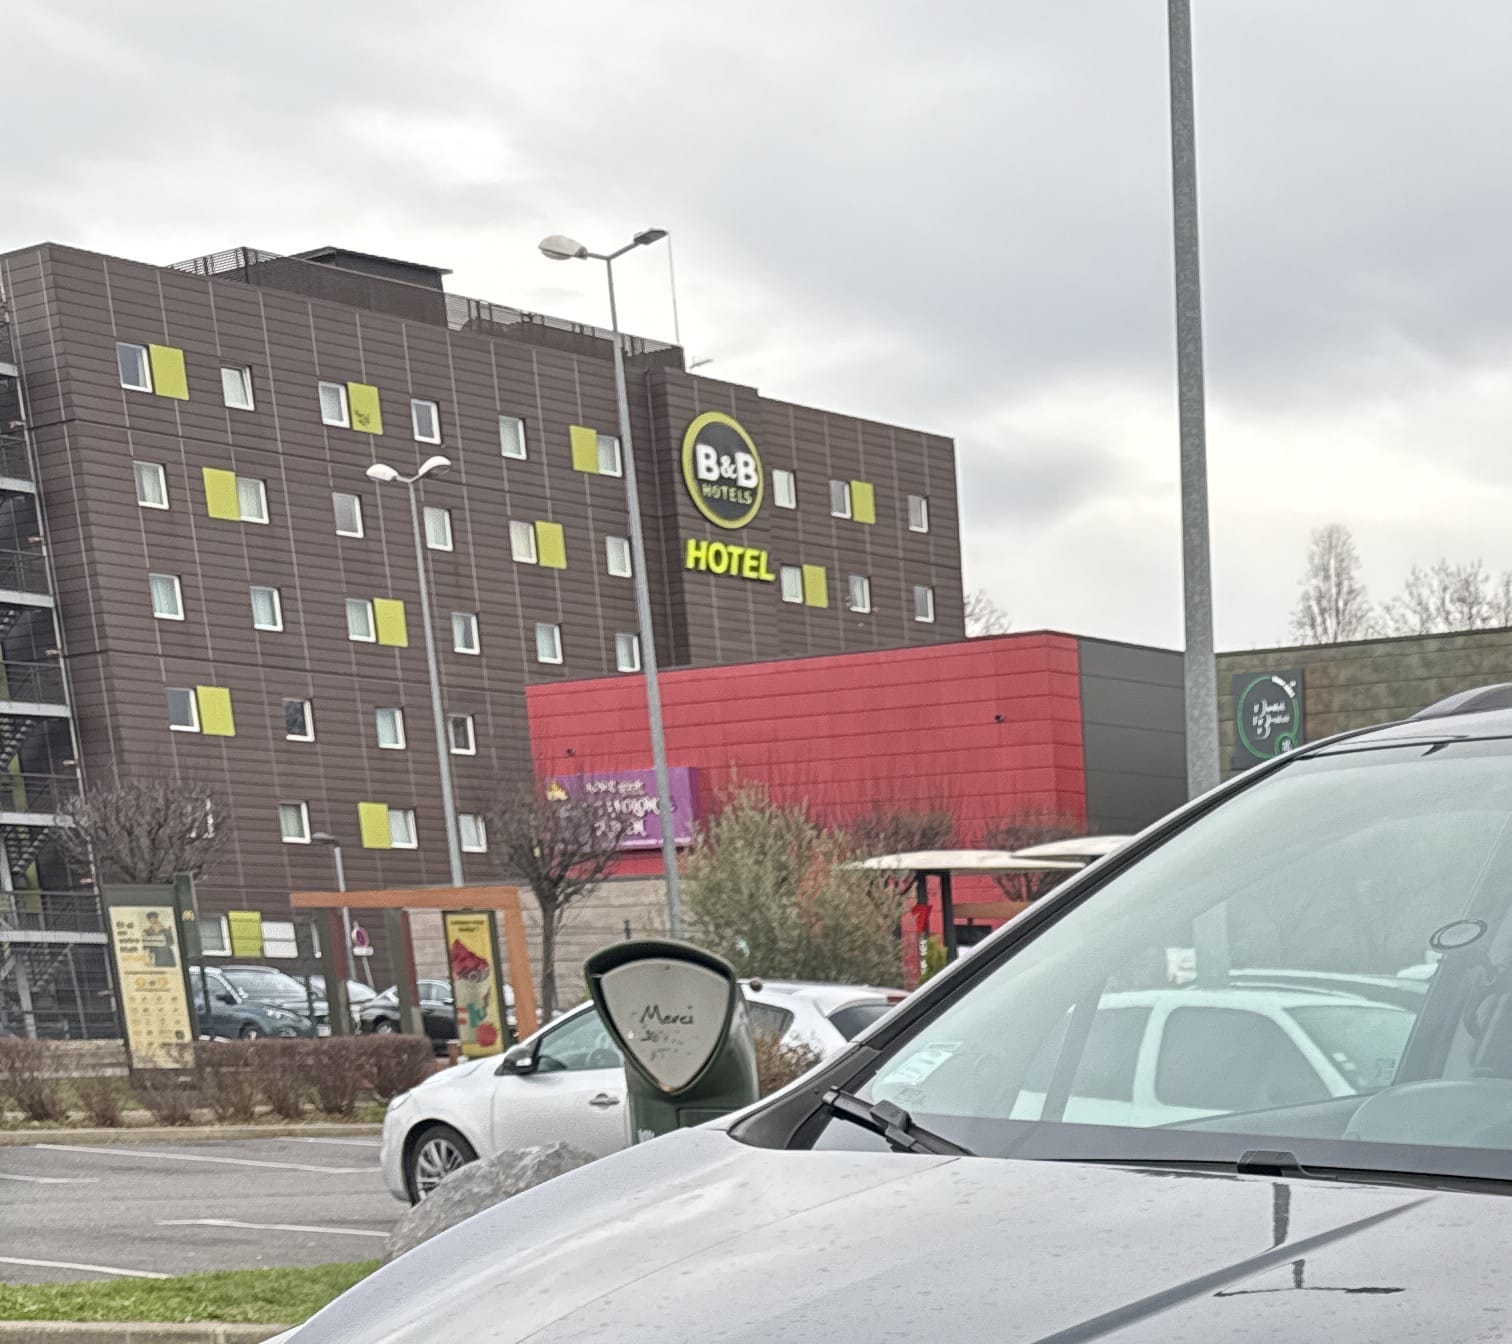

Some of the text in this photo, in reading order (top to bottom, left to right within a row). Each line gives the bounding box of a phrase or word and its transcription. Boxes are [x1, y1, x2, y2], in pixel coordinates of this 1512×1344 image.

[695, 443, 759, 489] B&B
[701, 482, 753, 505] HOTELS
[685, 537, 776, 582] HOTEL
[639, 1004, 694, 1025] Merci
